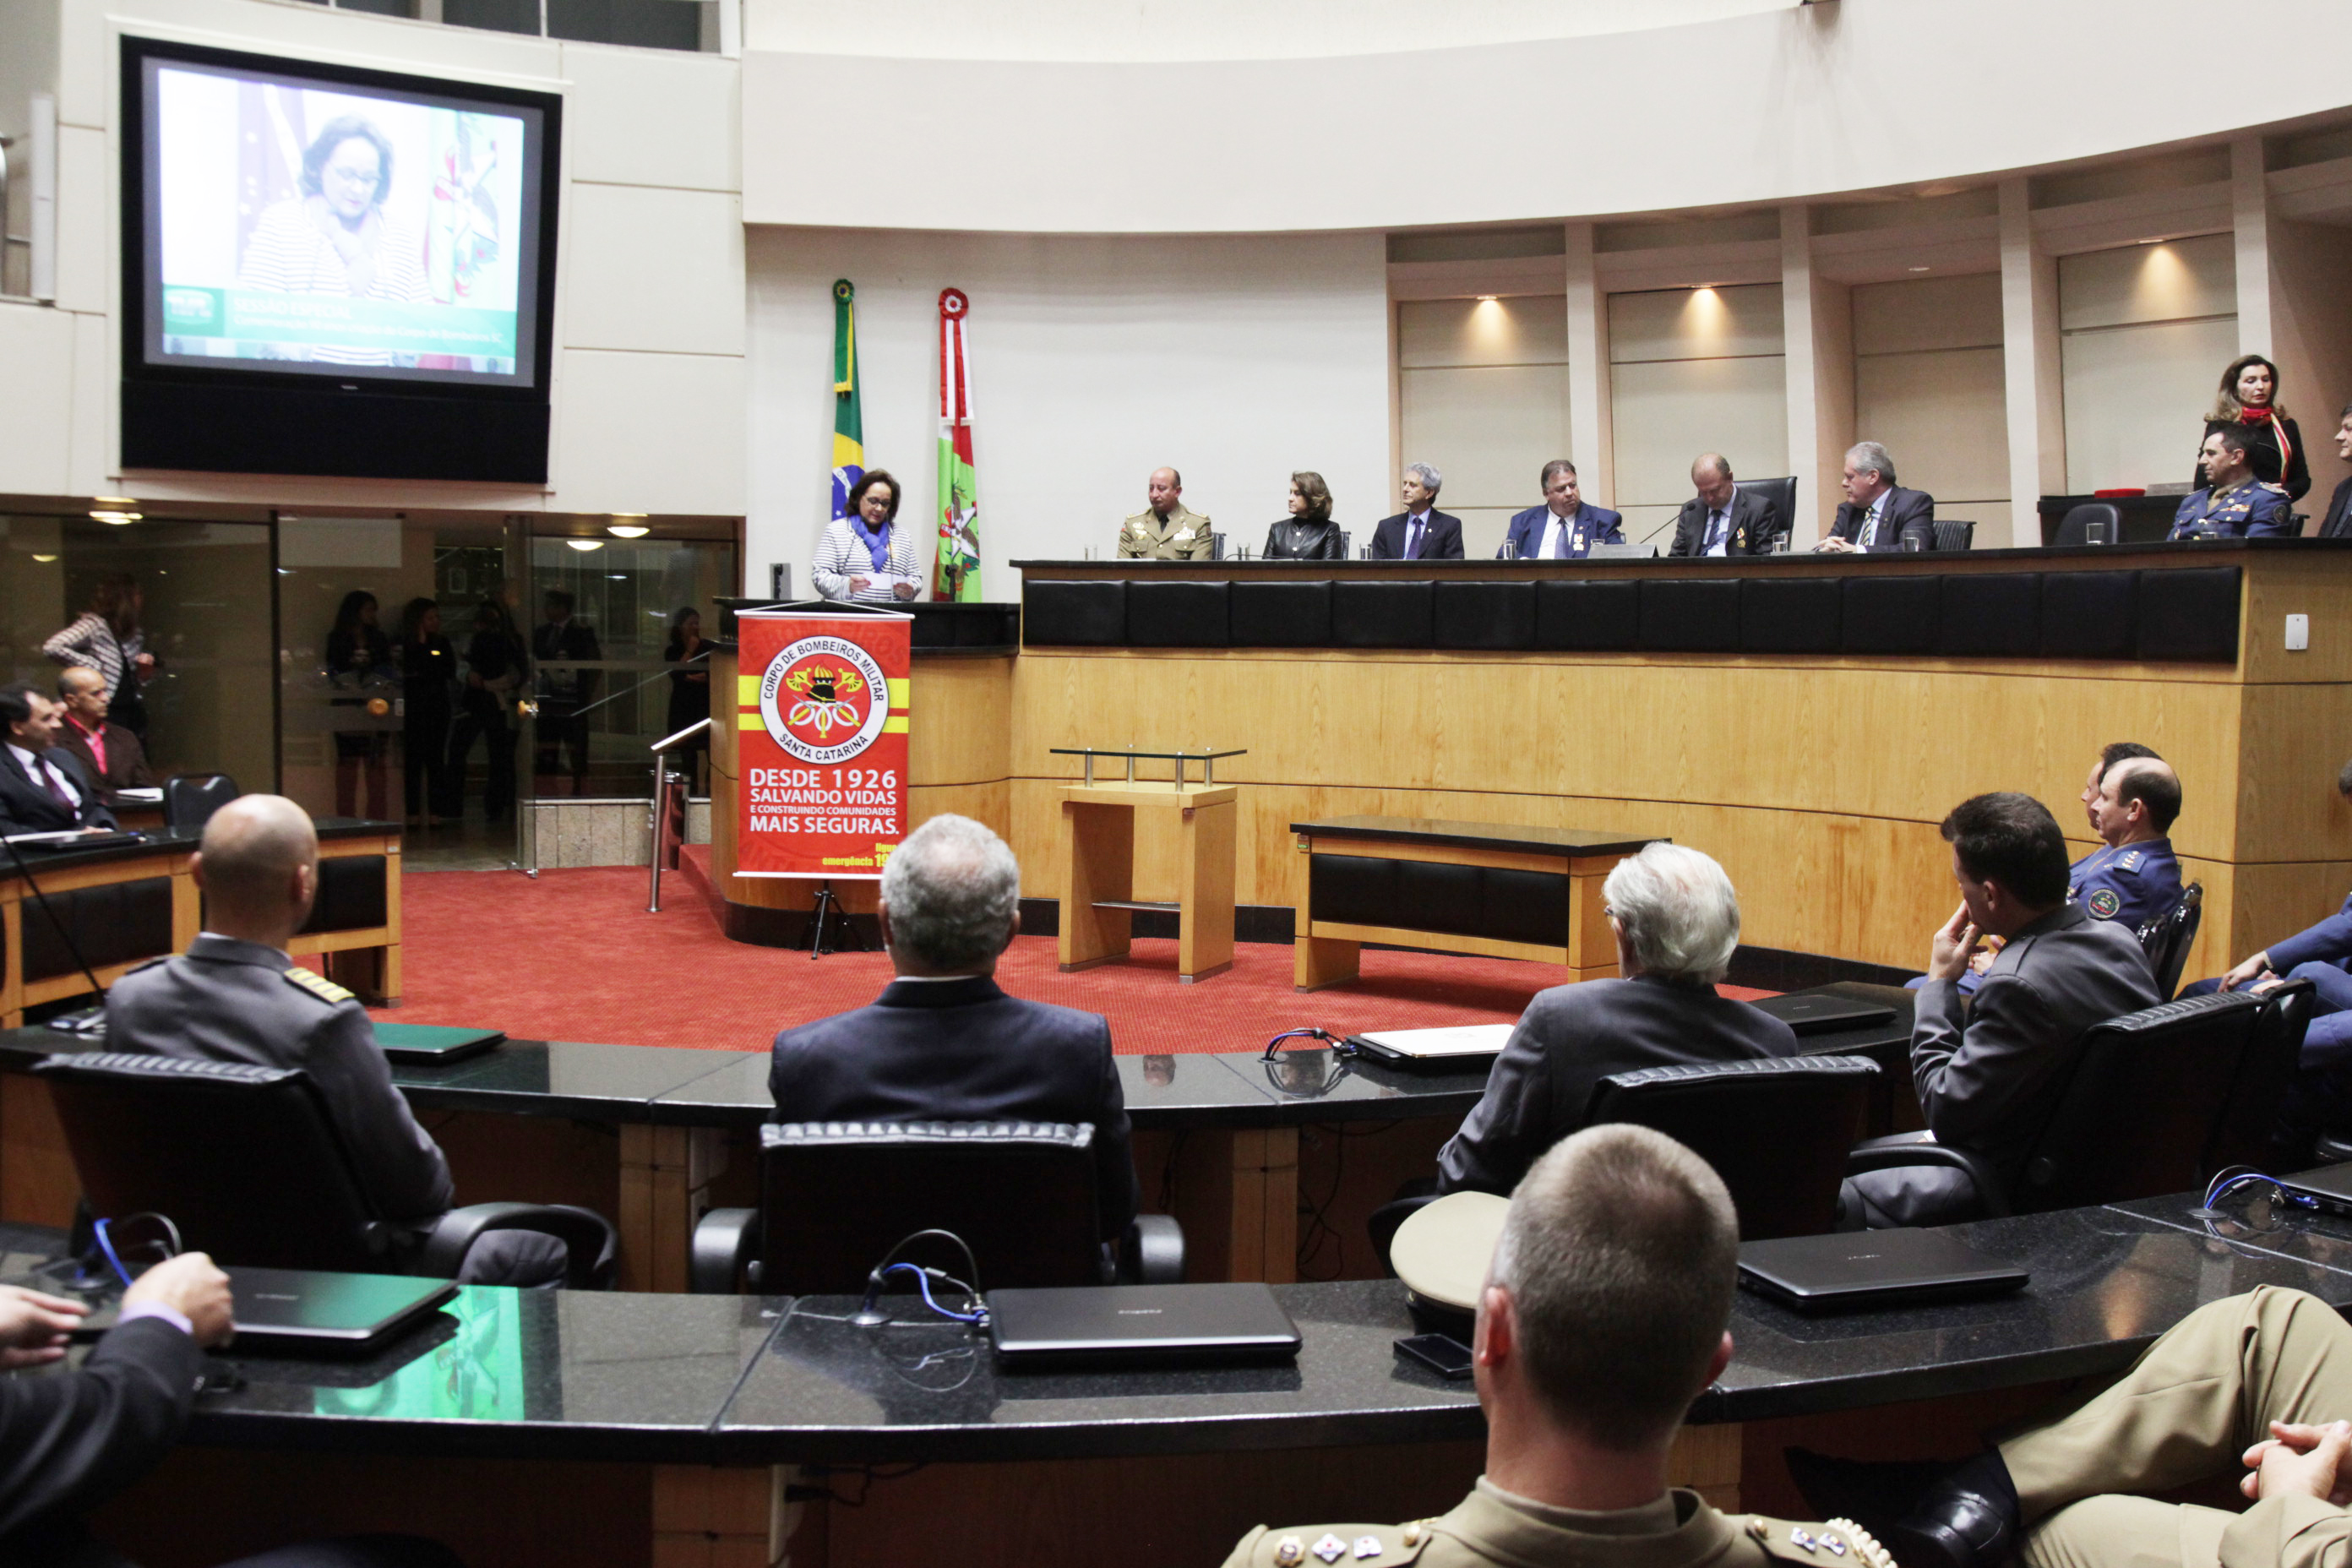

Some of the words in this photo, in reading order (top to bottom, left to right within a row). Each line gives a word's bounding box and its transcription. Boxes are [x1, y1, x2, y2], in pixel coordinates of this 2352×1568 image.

[764, 663, 783, 699] CORPO
[781, 650, 797, 664] DE
[797, 640, 862, 662] BOMBEIROS
[859, 659, 884, 701] MILITAR
[779, 733, 811, 758] SANTA
[815, 735, 868, 760] CATARINA
[750, 768, 820, 787] DESDE
[832, 769, 896, 789] 1926
[750, 788, 842, 803] SALVANDO
[845, 790, 896, 805] VIDAS
[758, 805, 825, 814] CONSTRUINDO
[826, 807, 896, 815] COMUNIDADES
[750, 815, 799, 833] MAIS
[804, 816, 900, 835] SEGURAS.
[822, 856, 874, 867] emergência
